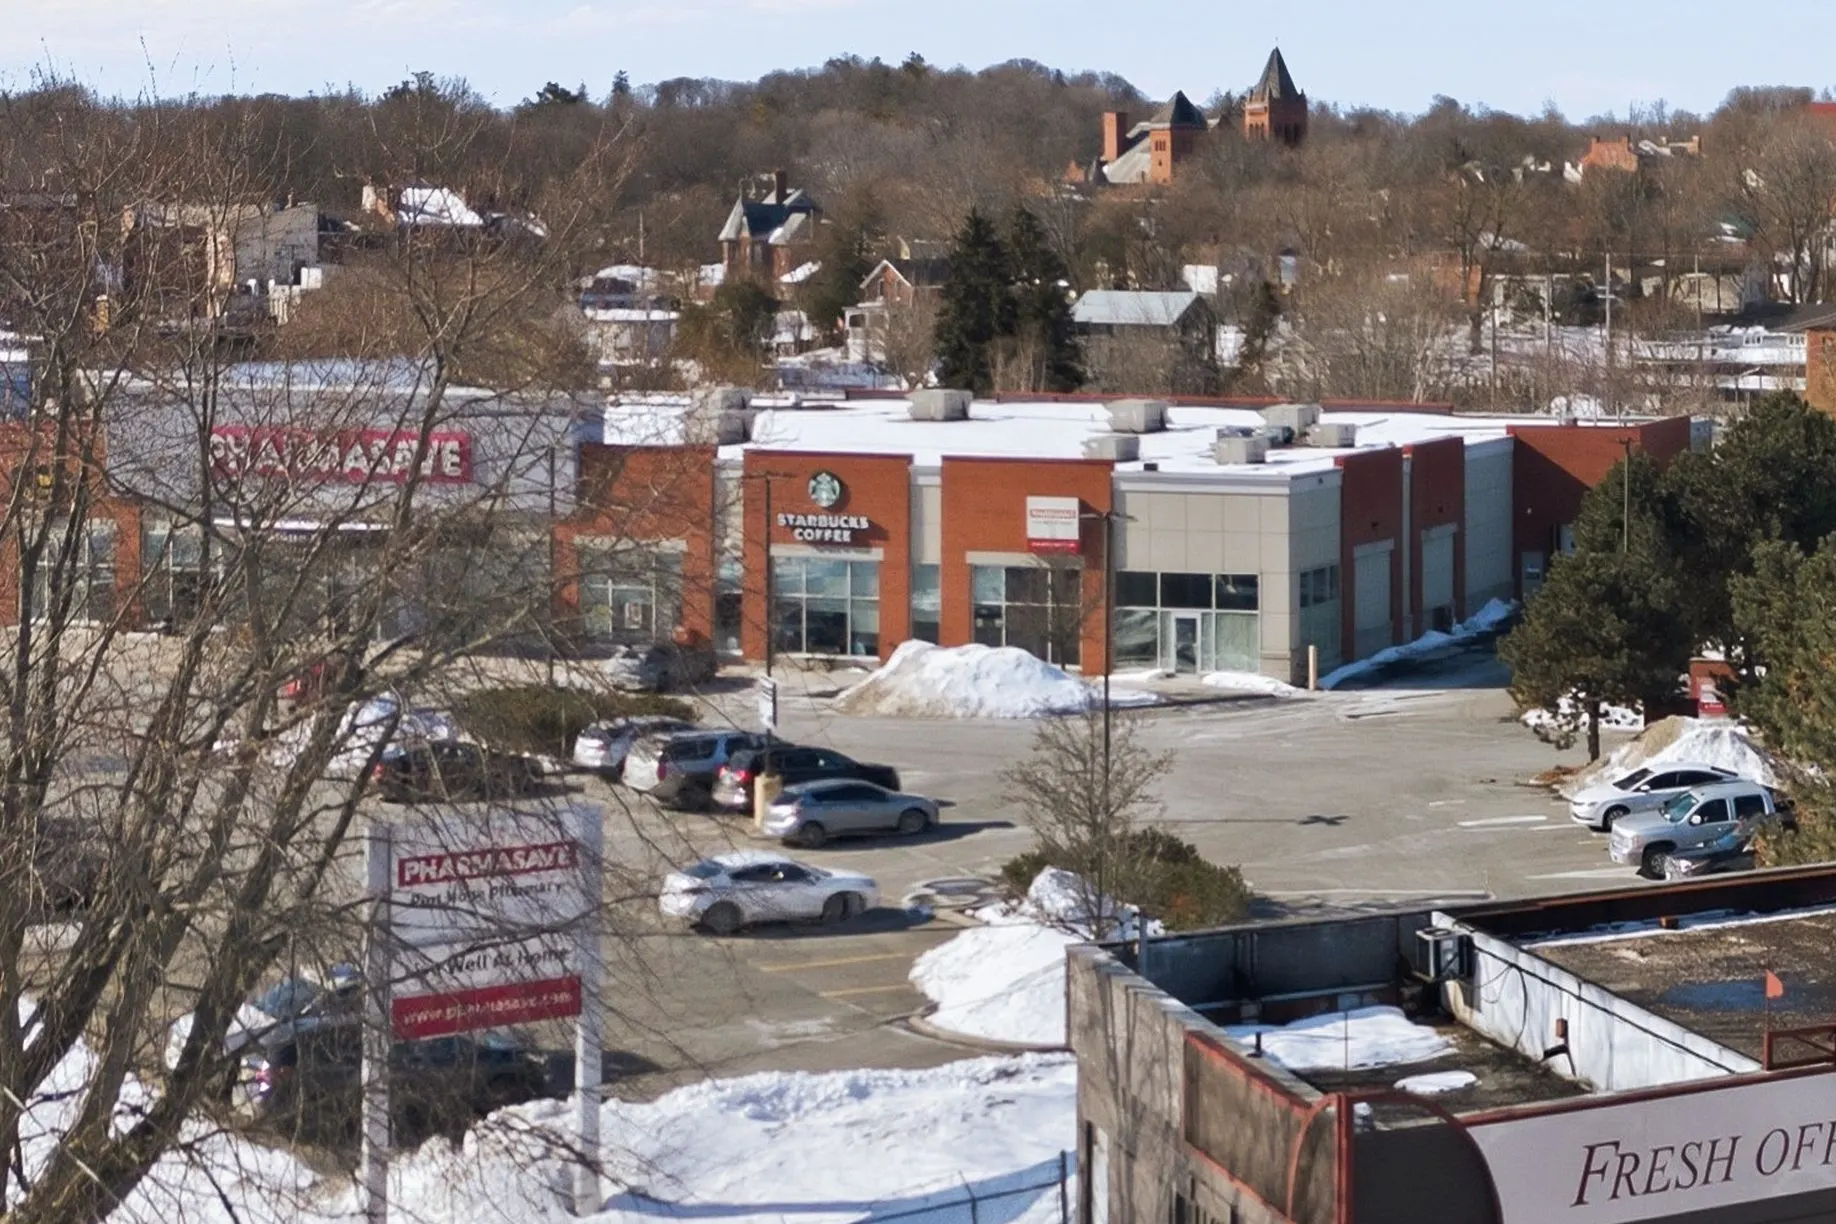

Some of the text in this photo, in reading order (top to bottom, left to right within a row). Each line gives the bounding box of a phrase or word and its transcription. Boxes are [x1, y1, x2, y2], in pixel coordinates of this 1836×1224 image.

[208, 432, 463, 476] PHAMASAVE
[777, 513, 869, 529] STARBUCKS
[793, 528, 852, 542] COFFEE
[1570, 1140, 1742, 1208] FRESH
